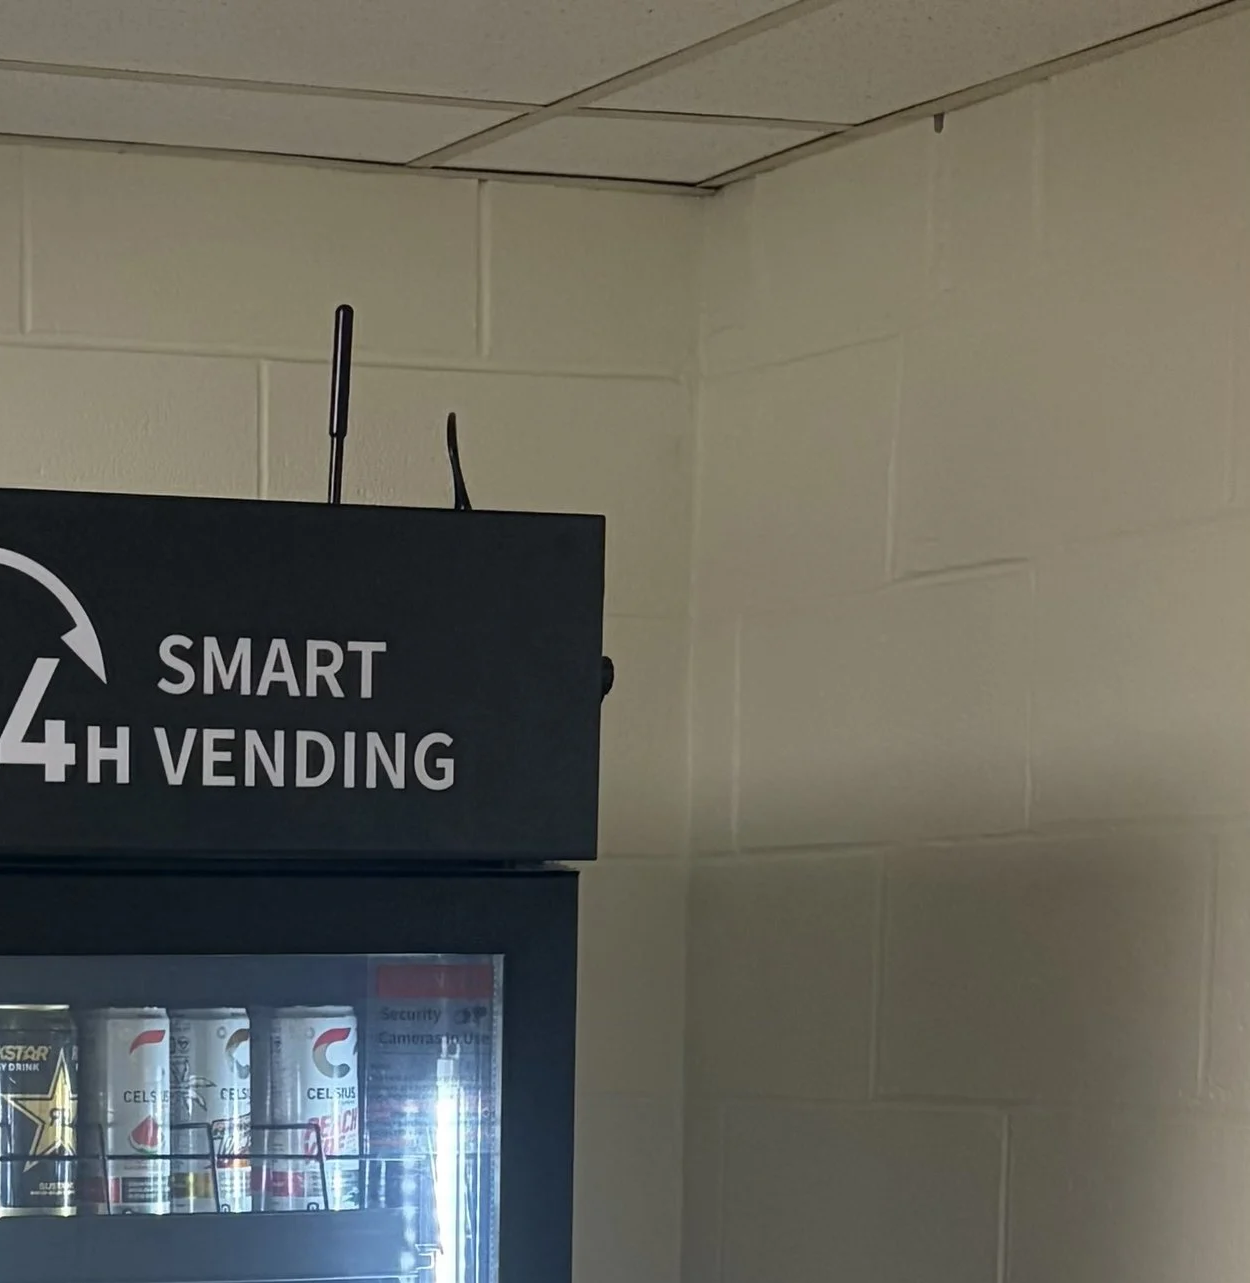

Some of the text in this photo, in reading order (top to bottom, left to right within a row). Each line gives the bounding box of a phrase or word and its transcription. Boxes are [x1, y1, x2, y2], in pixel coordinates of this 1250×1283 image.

[157, 634, 387, 699] SMART
[153, 727, 455, 791] VENDING
[381, 1007, 442, 1023] Security
[378, 1032, 440, 1045] Cameras
[8, 1063, 40, 1072] DRINK
[306, 1086, 356, 1100] CELSIUS
